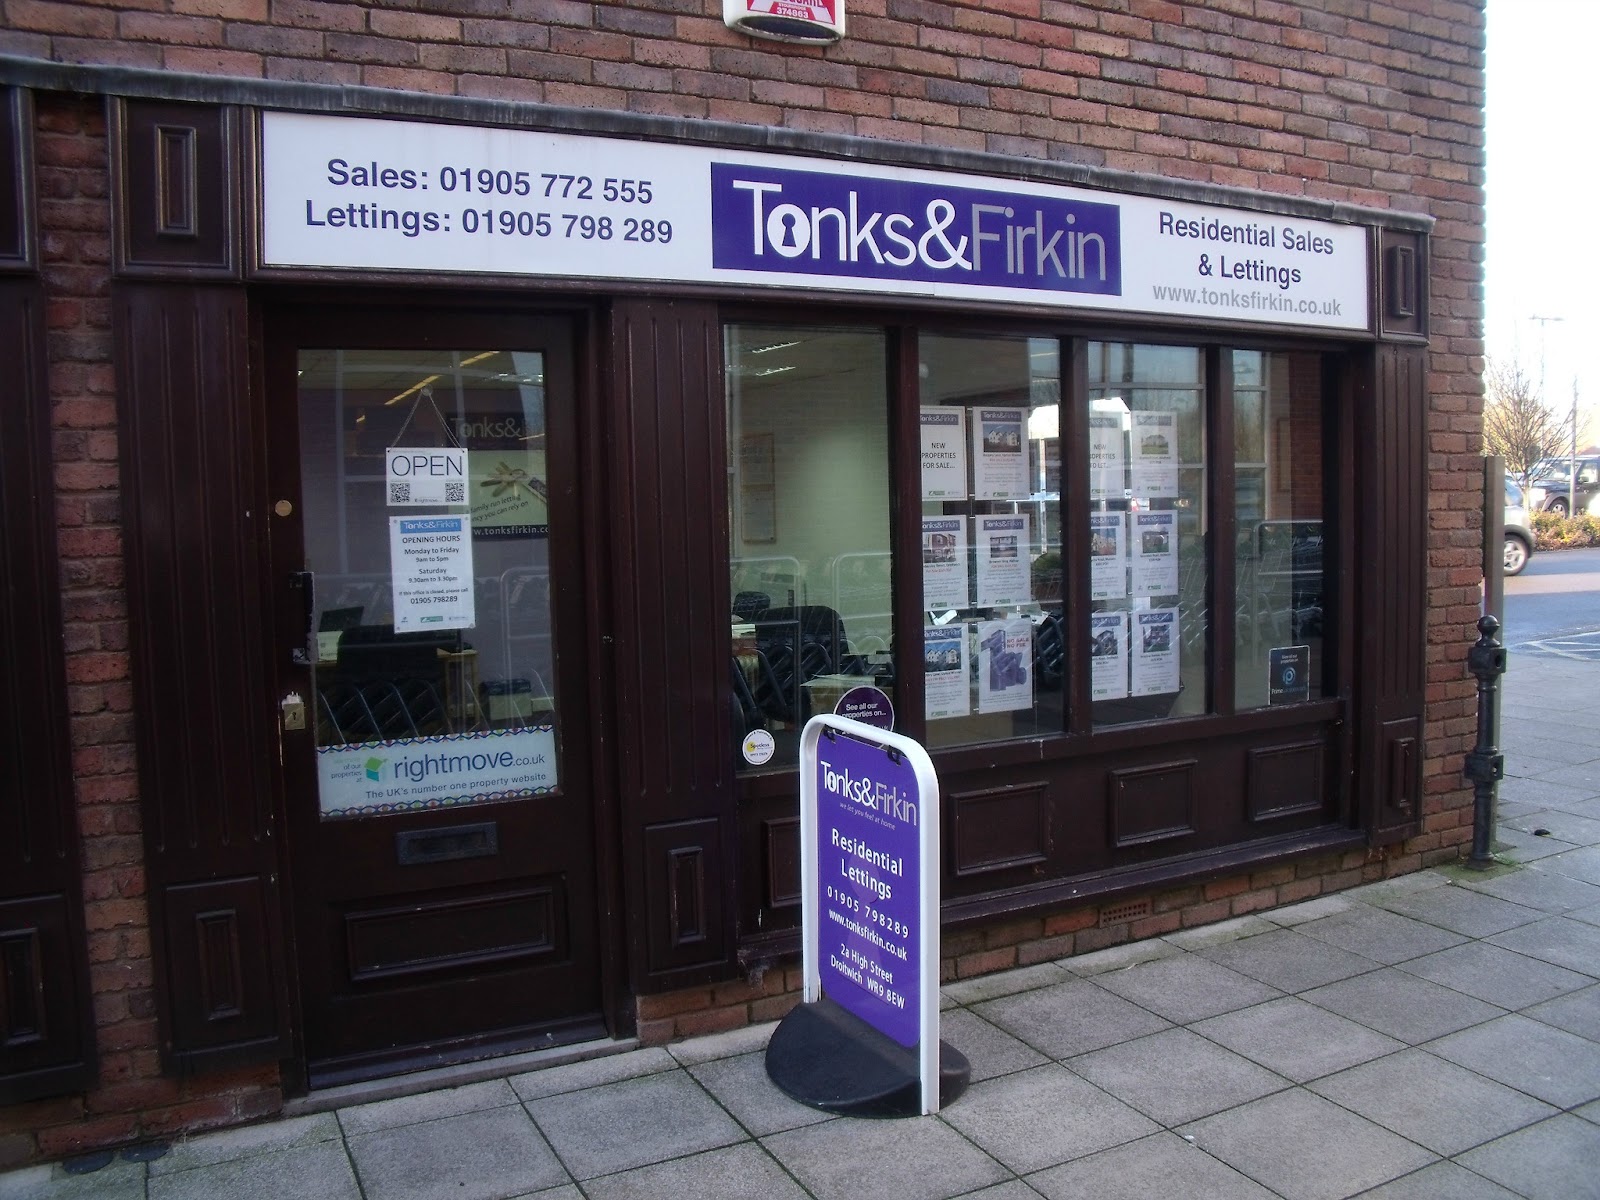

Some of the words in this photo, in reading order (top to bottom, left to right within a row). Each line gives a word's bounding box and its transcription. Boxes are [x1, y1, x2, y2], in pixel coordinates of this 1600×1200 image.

[776, 7, 809, 18] 374863
[327, 158, 428, 189] Sales:
[439, 165, 531, 196] 01905
[541, 173, 593, 200] 772
[603, 177, 653, 204] 555
[306, 199, 450, 237] Lettings:
[462, 208, 552, 237] 01905
[562, 214, 614, 241] 798
[624, 217, 674, 243] 289
[733, 180, 1107, 282] Tonks&Firkin
[1159, 211, 1275, 248] Residential
[1282, 227, 1334, 254] Sales
[1198, 253, 1213, 276] &
[1221, 255, 1301, 290] Lettings
[1153, 285, 1342, 316] www.tonksfirkin.co.uk
[391, 455, 463, 477] OPEN
[497, 507, 508, 515] can
[402, 536, 434, 544] OPENING
[436, 535, 461, 543] HOURS
[418, 567, 448, 575] Saturday
[410, 597, 432, 605] 01905
[433, 595, 458, 603] 798289
[845, 703, 859, 711] See
[859, 702, 867, 710] all
[867, 702, 879, 710] our
[365, 790, 384, 800] The
[386, 788, 409, 798] UK's
[411, 785, 447, 796] number
[449, 782, 467, 791] one
[470, 777, 509, 790] property
[511, 773, 547, 784] website
[820, 760, 917, 826] Tonks&Firkin
[847, 803, 855, 812] let
[854, 807, 864, 818] you
[864, 809, 874, 820] feel
[874, 814, 881, 822] at
[880, 815, 896, 831] home
[832, 828, 903, 877] Residential
[841, 858, 892, 900] Lettings
[827, 885, 859, 912] 01905
[865, 905, 909, 938] 798289
[829, 909, 908, 961] www.tonksfirkin.co.uk
[830, 954, 863, 985] Droitwich
[866, 976, 884, 997] WR9
[886, 989, 906, 1010] 8EW
[841, 943, 851, 959] 2a
[851, 949, 869, 970] High
[869, 960, 894, 985] Street
